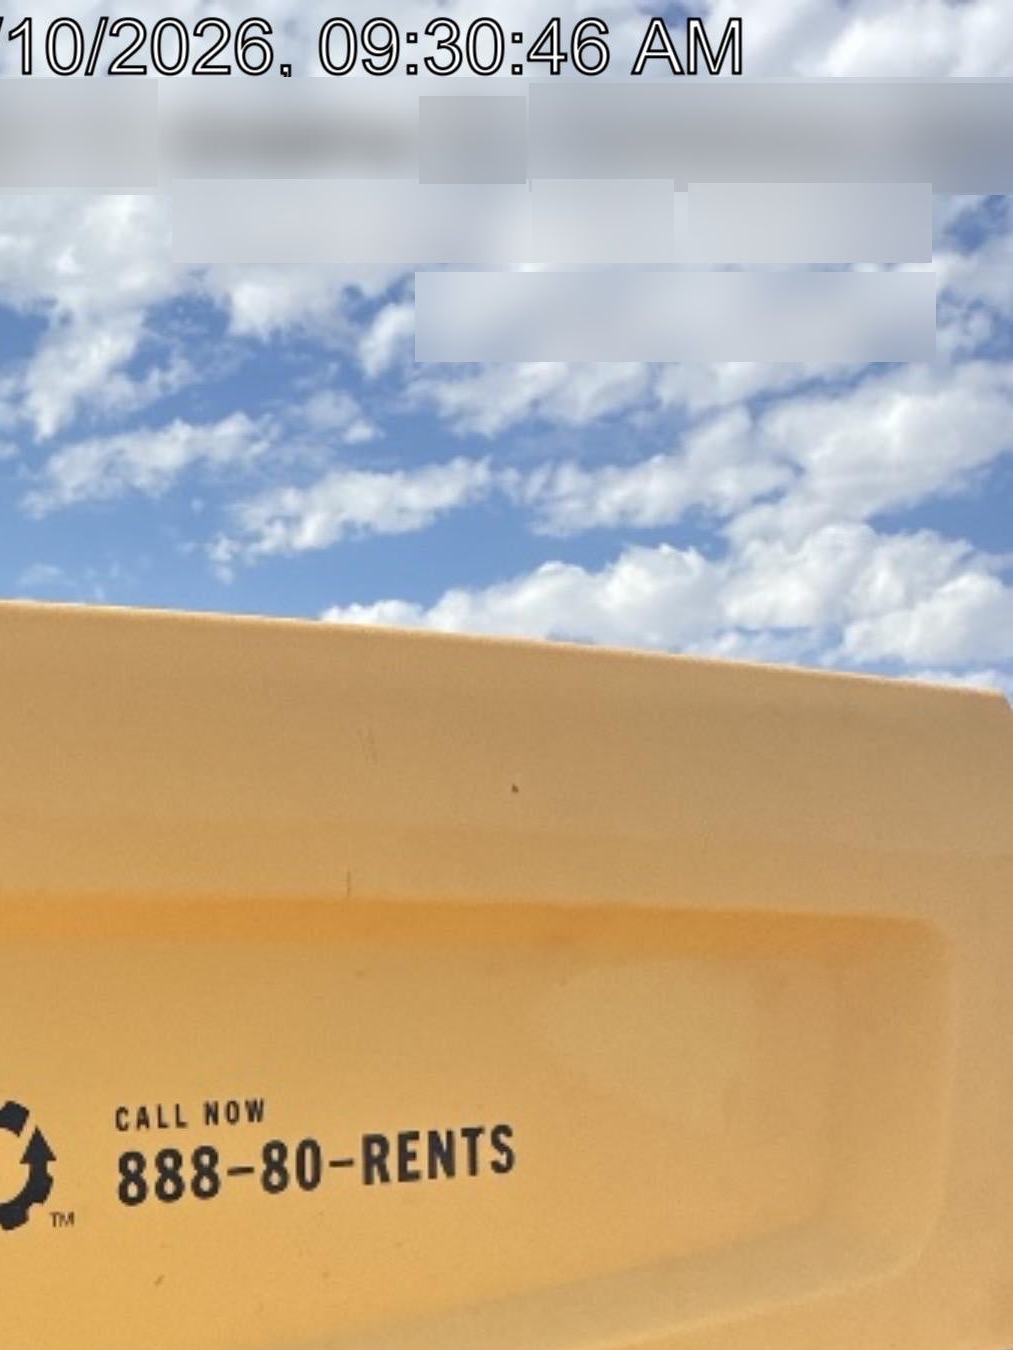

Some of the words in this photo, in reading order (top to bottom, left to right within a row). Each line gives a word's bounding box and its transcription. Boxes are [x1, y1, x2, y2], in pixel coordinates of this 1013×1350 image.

[115, 1104, 187, 1132] CALL
[203, 1098, 266, 1126] NOW
[118, 1124, 515, 1207] 888-80-RENTS
